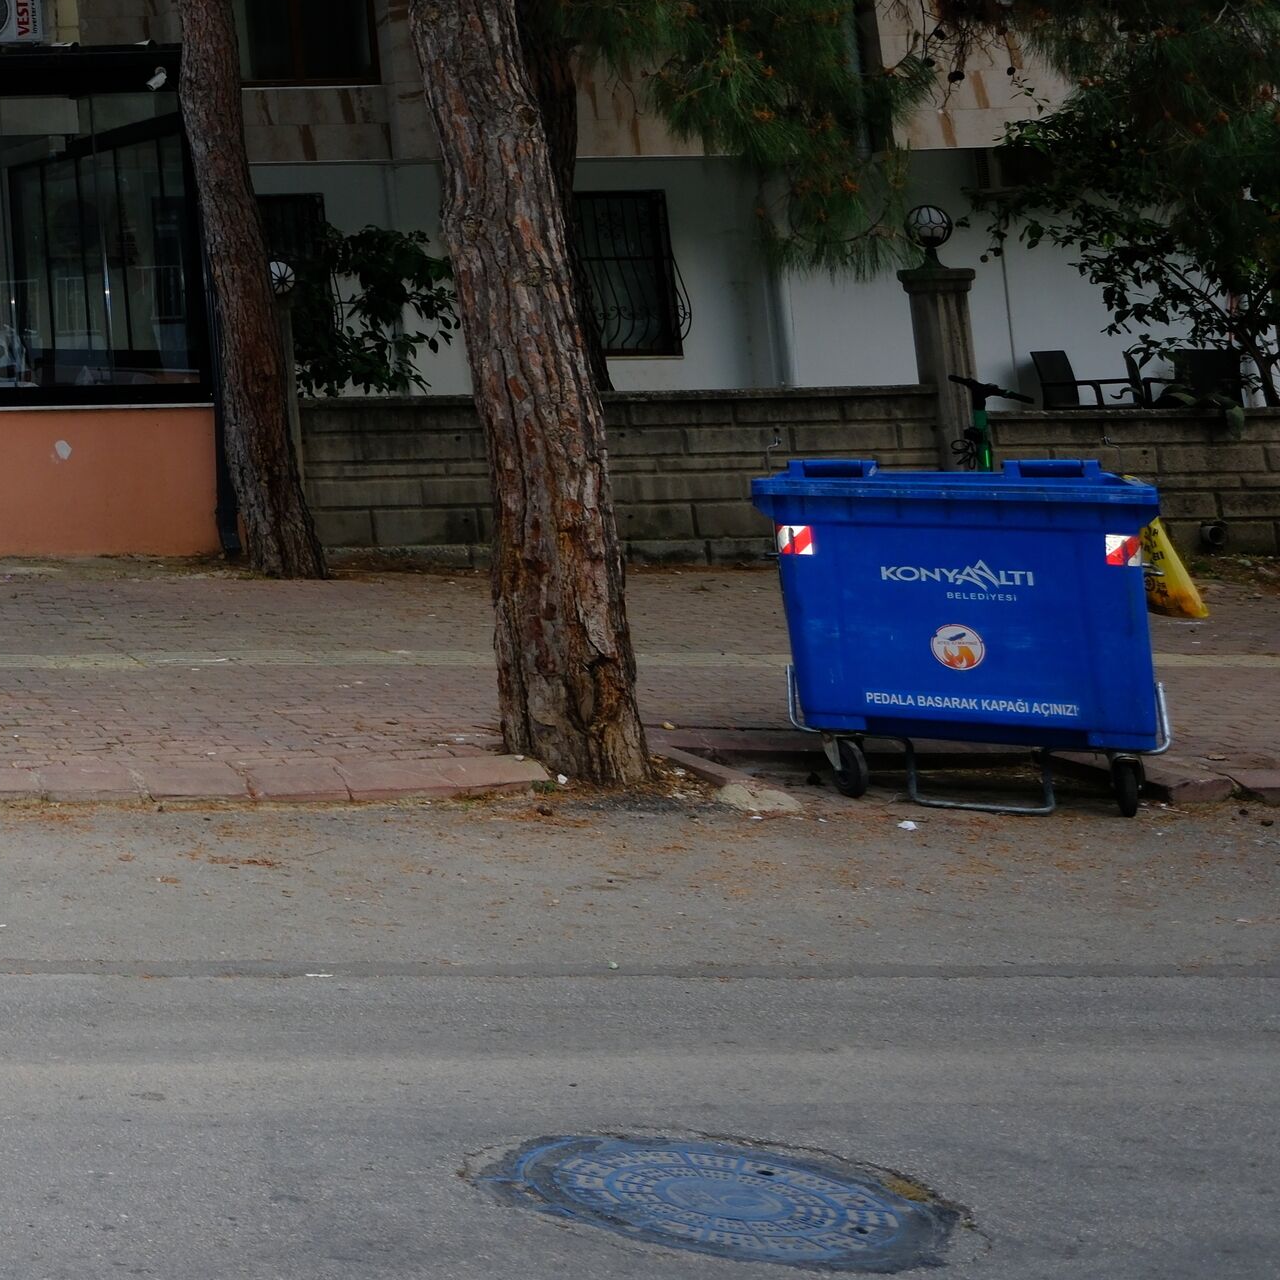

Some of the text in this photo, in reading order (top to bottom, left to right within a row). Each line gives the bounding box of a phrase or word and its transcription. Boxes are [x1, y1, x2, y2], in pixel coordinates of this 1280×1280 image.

[880, 560, 1035, 591] KONYAALTI
[866, 691, 915, 707] PEDALA
[917, 694, 979, 710] BASARAK
[981, 696, 1030, 713] KAPAĞI
